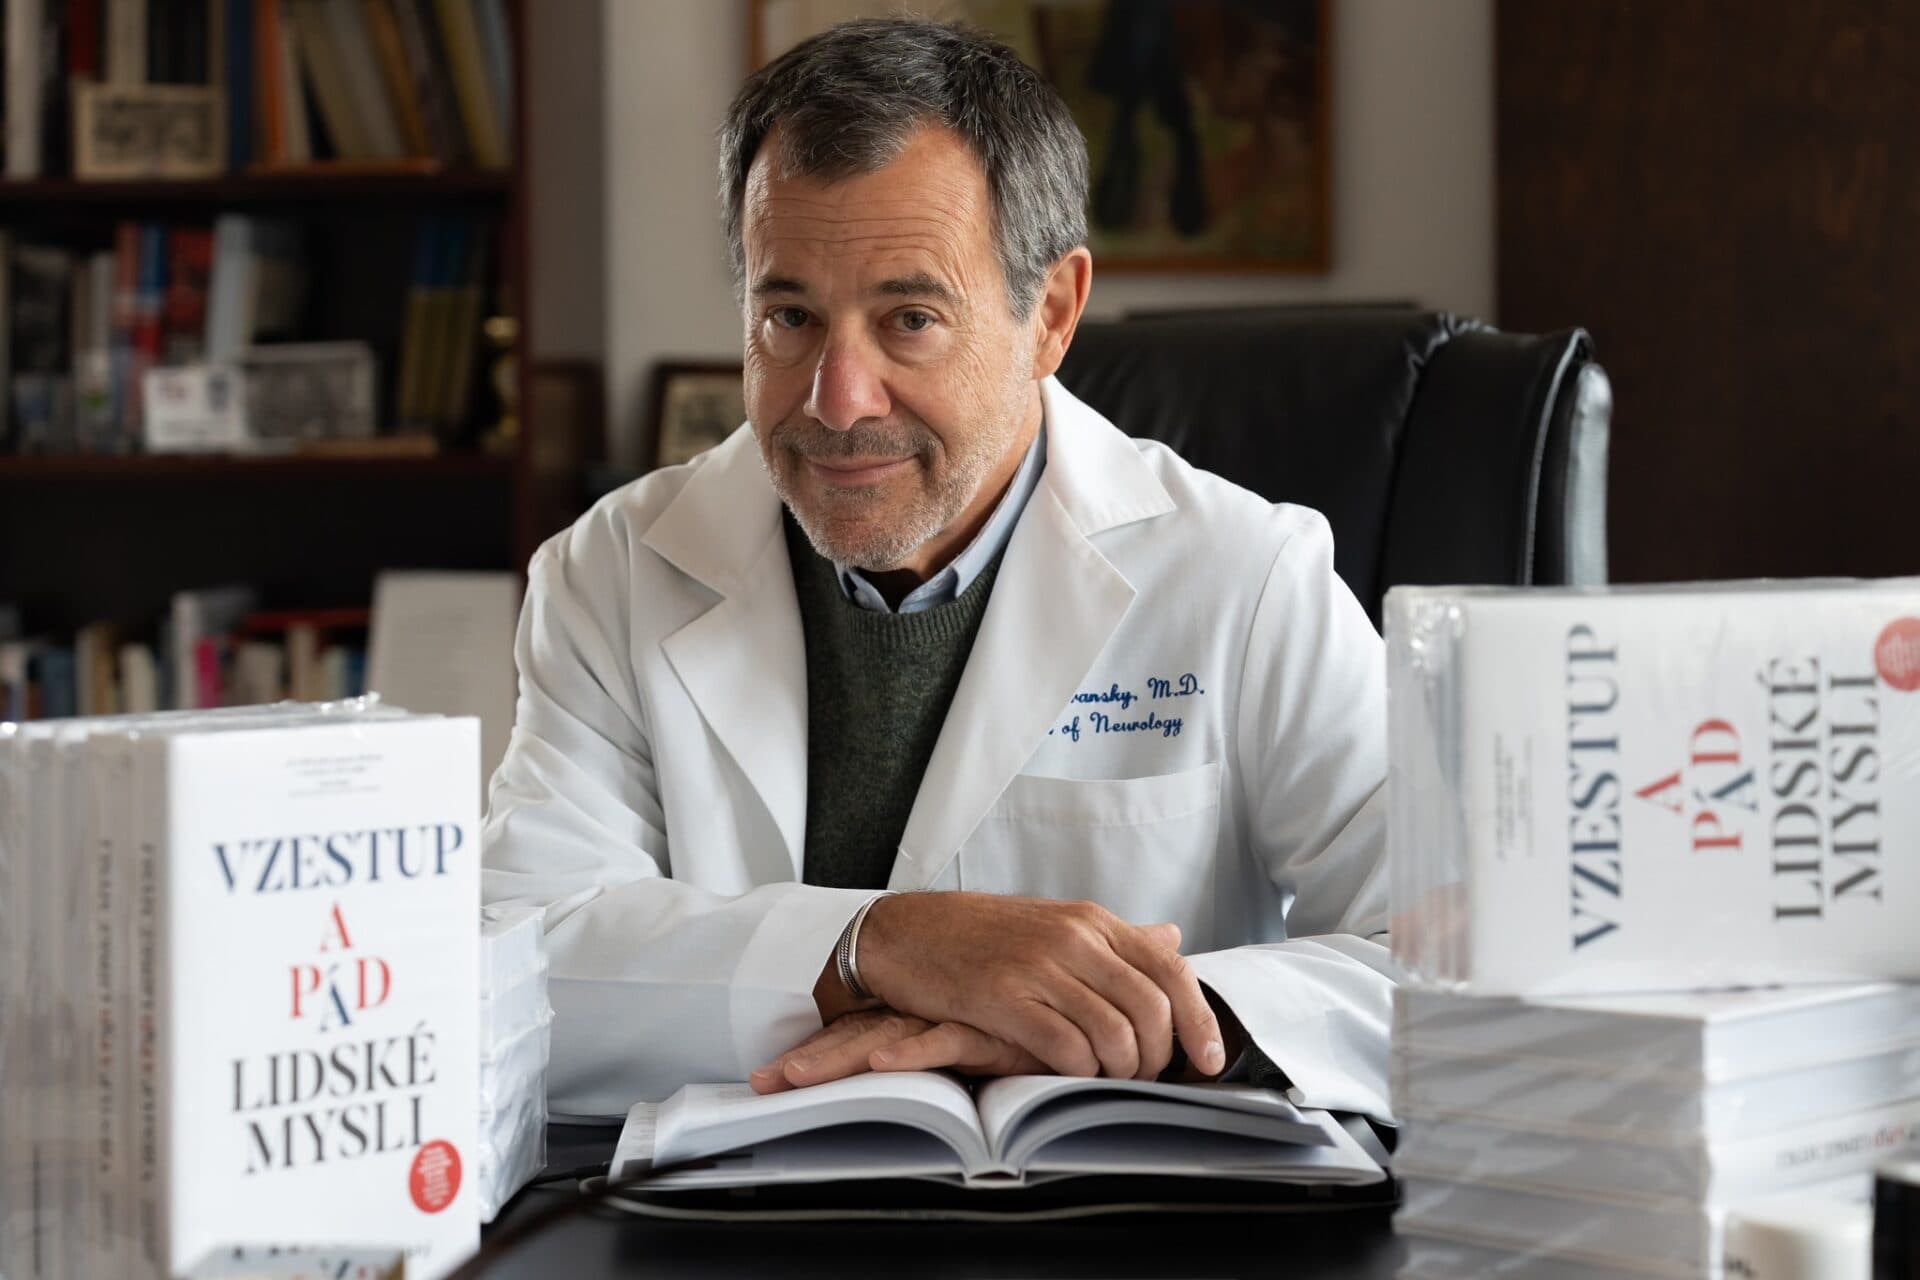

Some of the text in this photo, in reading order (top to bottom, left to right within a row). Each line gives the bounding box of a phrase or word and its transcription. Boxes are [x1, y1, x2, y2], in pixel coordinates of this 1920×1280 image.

[1147, 673, 1205, 699] M.D.
[1061, 711, 1184, 742] of Neurology
[1566, 622, 1624, 952] VZESTUP
[1634, 770, 1684, 814] A
[1689, 717, 1760, 852] PÁD
[1757, 656, 1825, 922] LIDSKÉ
[1828, 674, 1884, 903] MYSLI
[212, 823, 465, 893] VZESTUP
[319, 901, 353, 953] A
[288, 957, 392, 1034] PÁD
[231, 1020, 438, 1114] LIDSKÉ
[245, 1096, 424, 1176] MYSLI
